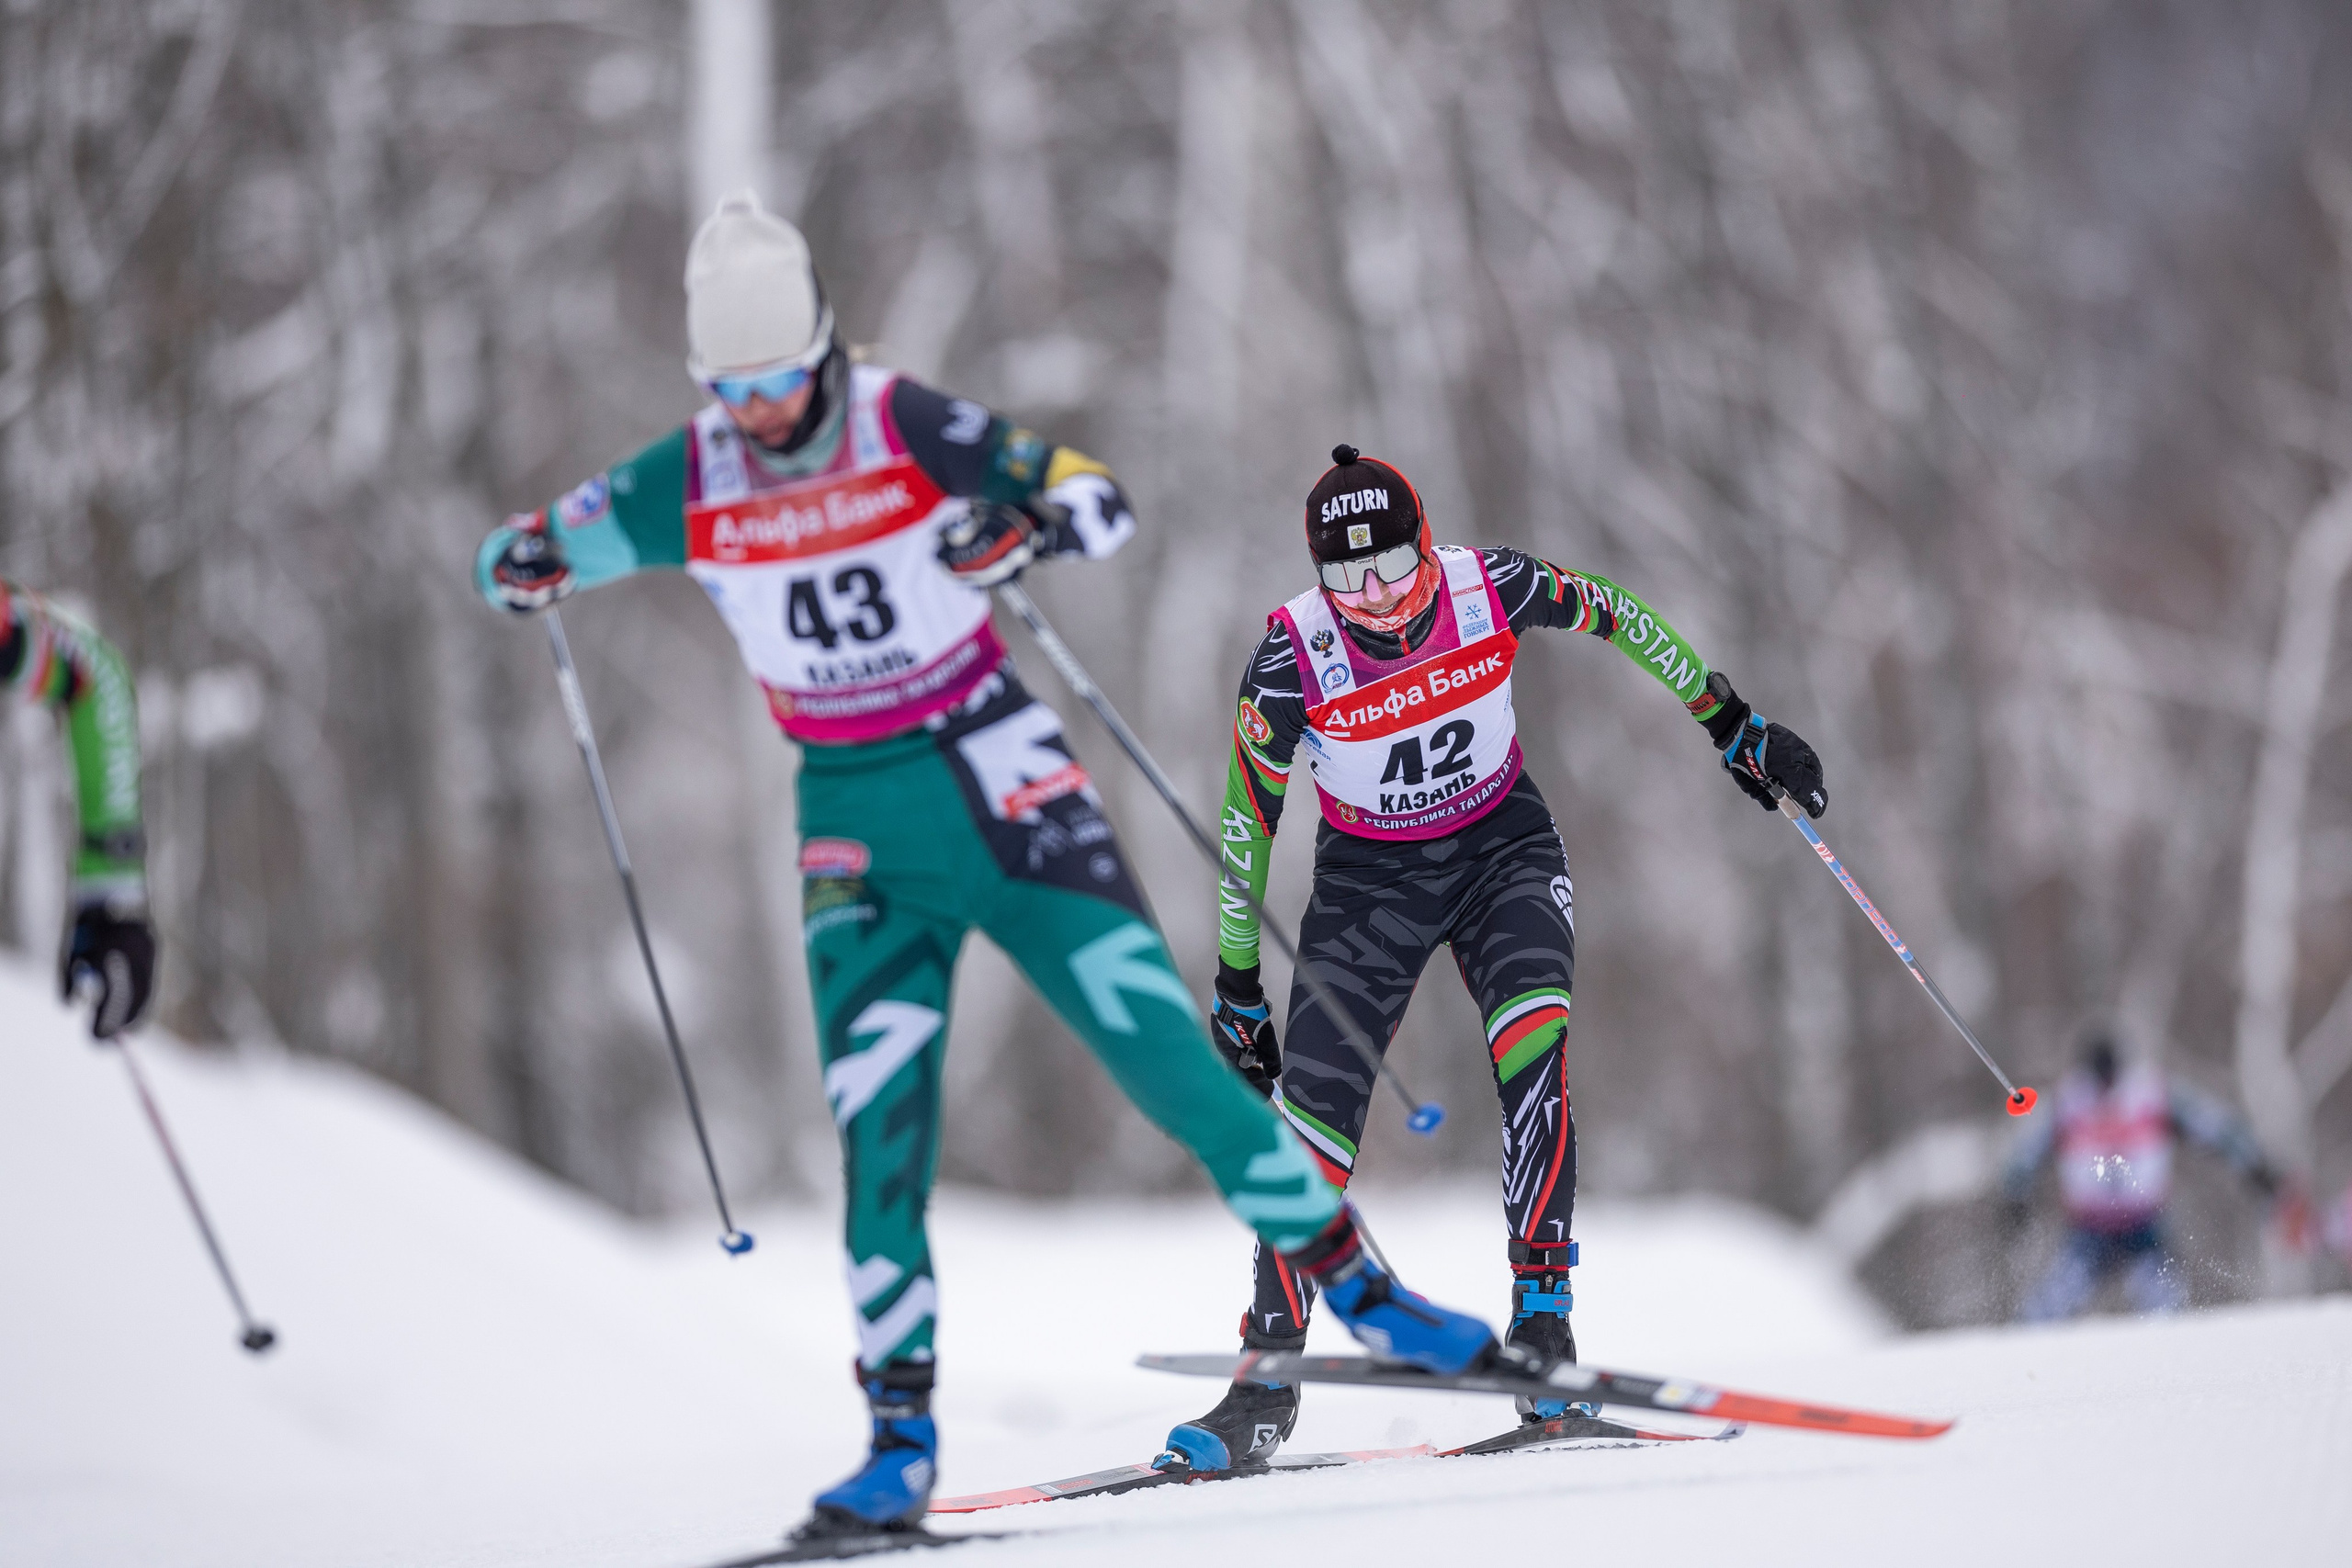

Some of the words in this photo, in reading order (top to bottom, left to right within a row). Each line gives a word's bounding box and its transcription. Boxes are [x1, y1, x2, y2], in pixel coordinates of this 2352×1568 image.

[712, 504, 824, 549] Альфа
[824, 479, 915, 531] Банк
[1321, 488, 1389, 524] SATURN
[787, 567, 895, 649] 43
[1464, 627, 1484, 638] ГОНОК
[1324, 688, 1426, 728] Альфа
[1428, 651, 1505, 697] Банк
[1380, 719, 1475, 785] 42
[1363, 806, 1456, 829] РЕСПУБЛИКА
[1380, 772, 1476, 814] КАЗАНЬ
